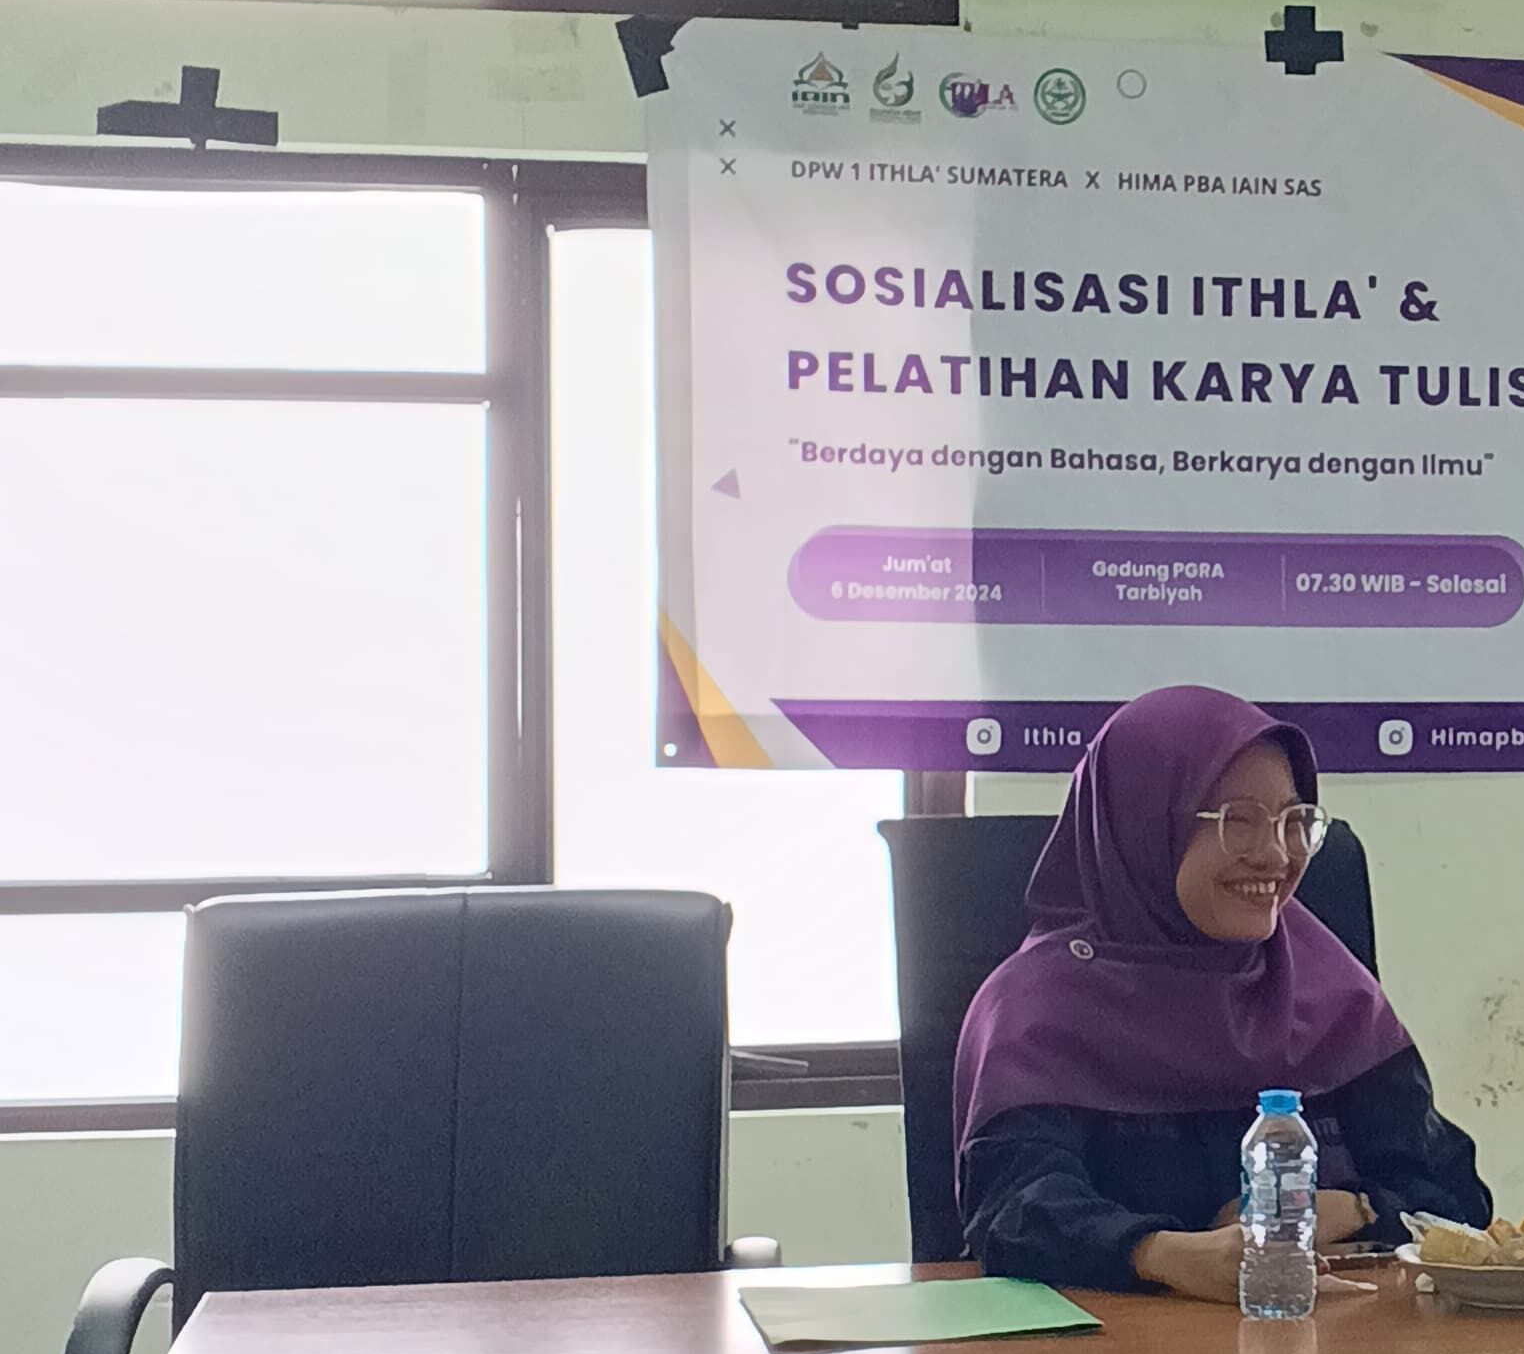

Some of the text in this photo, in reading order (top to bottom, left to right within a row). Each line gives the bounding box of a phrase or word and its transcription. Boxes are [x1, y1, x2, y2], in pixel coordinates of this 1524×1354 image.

[791, 160, 1323, 197] DPW 1 ITHLA' SUMATERA X HIMA PBA IAIN SAS
[785, 262, 1440, 322] SOSIALISASI ITHLA' &
[787, 350, 1128, 401] PELATIHAN
[1152, 359, 1360, 405] KARYA
[788, 437, 1495, 482] "Berdaya dengan Bahasa, Berkarya dengan Ilmu"
[882, 554, 952, 574] Jum'at
[1091, 560, 1225, 583] Gedung PGRA
[848, 581, 951, 601] Desember
[954, 583, 1003, 602] 2024
[1115, 583, 1203, 606] Tarbiyah
[1295, 572, 1356, 593] 07.30
[1361, 573, 1405, 593] WIB
[1426, 572, 1507, 594] Selesai
